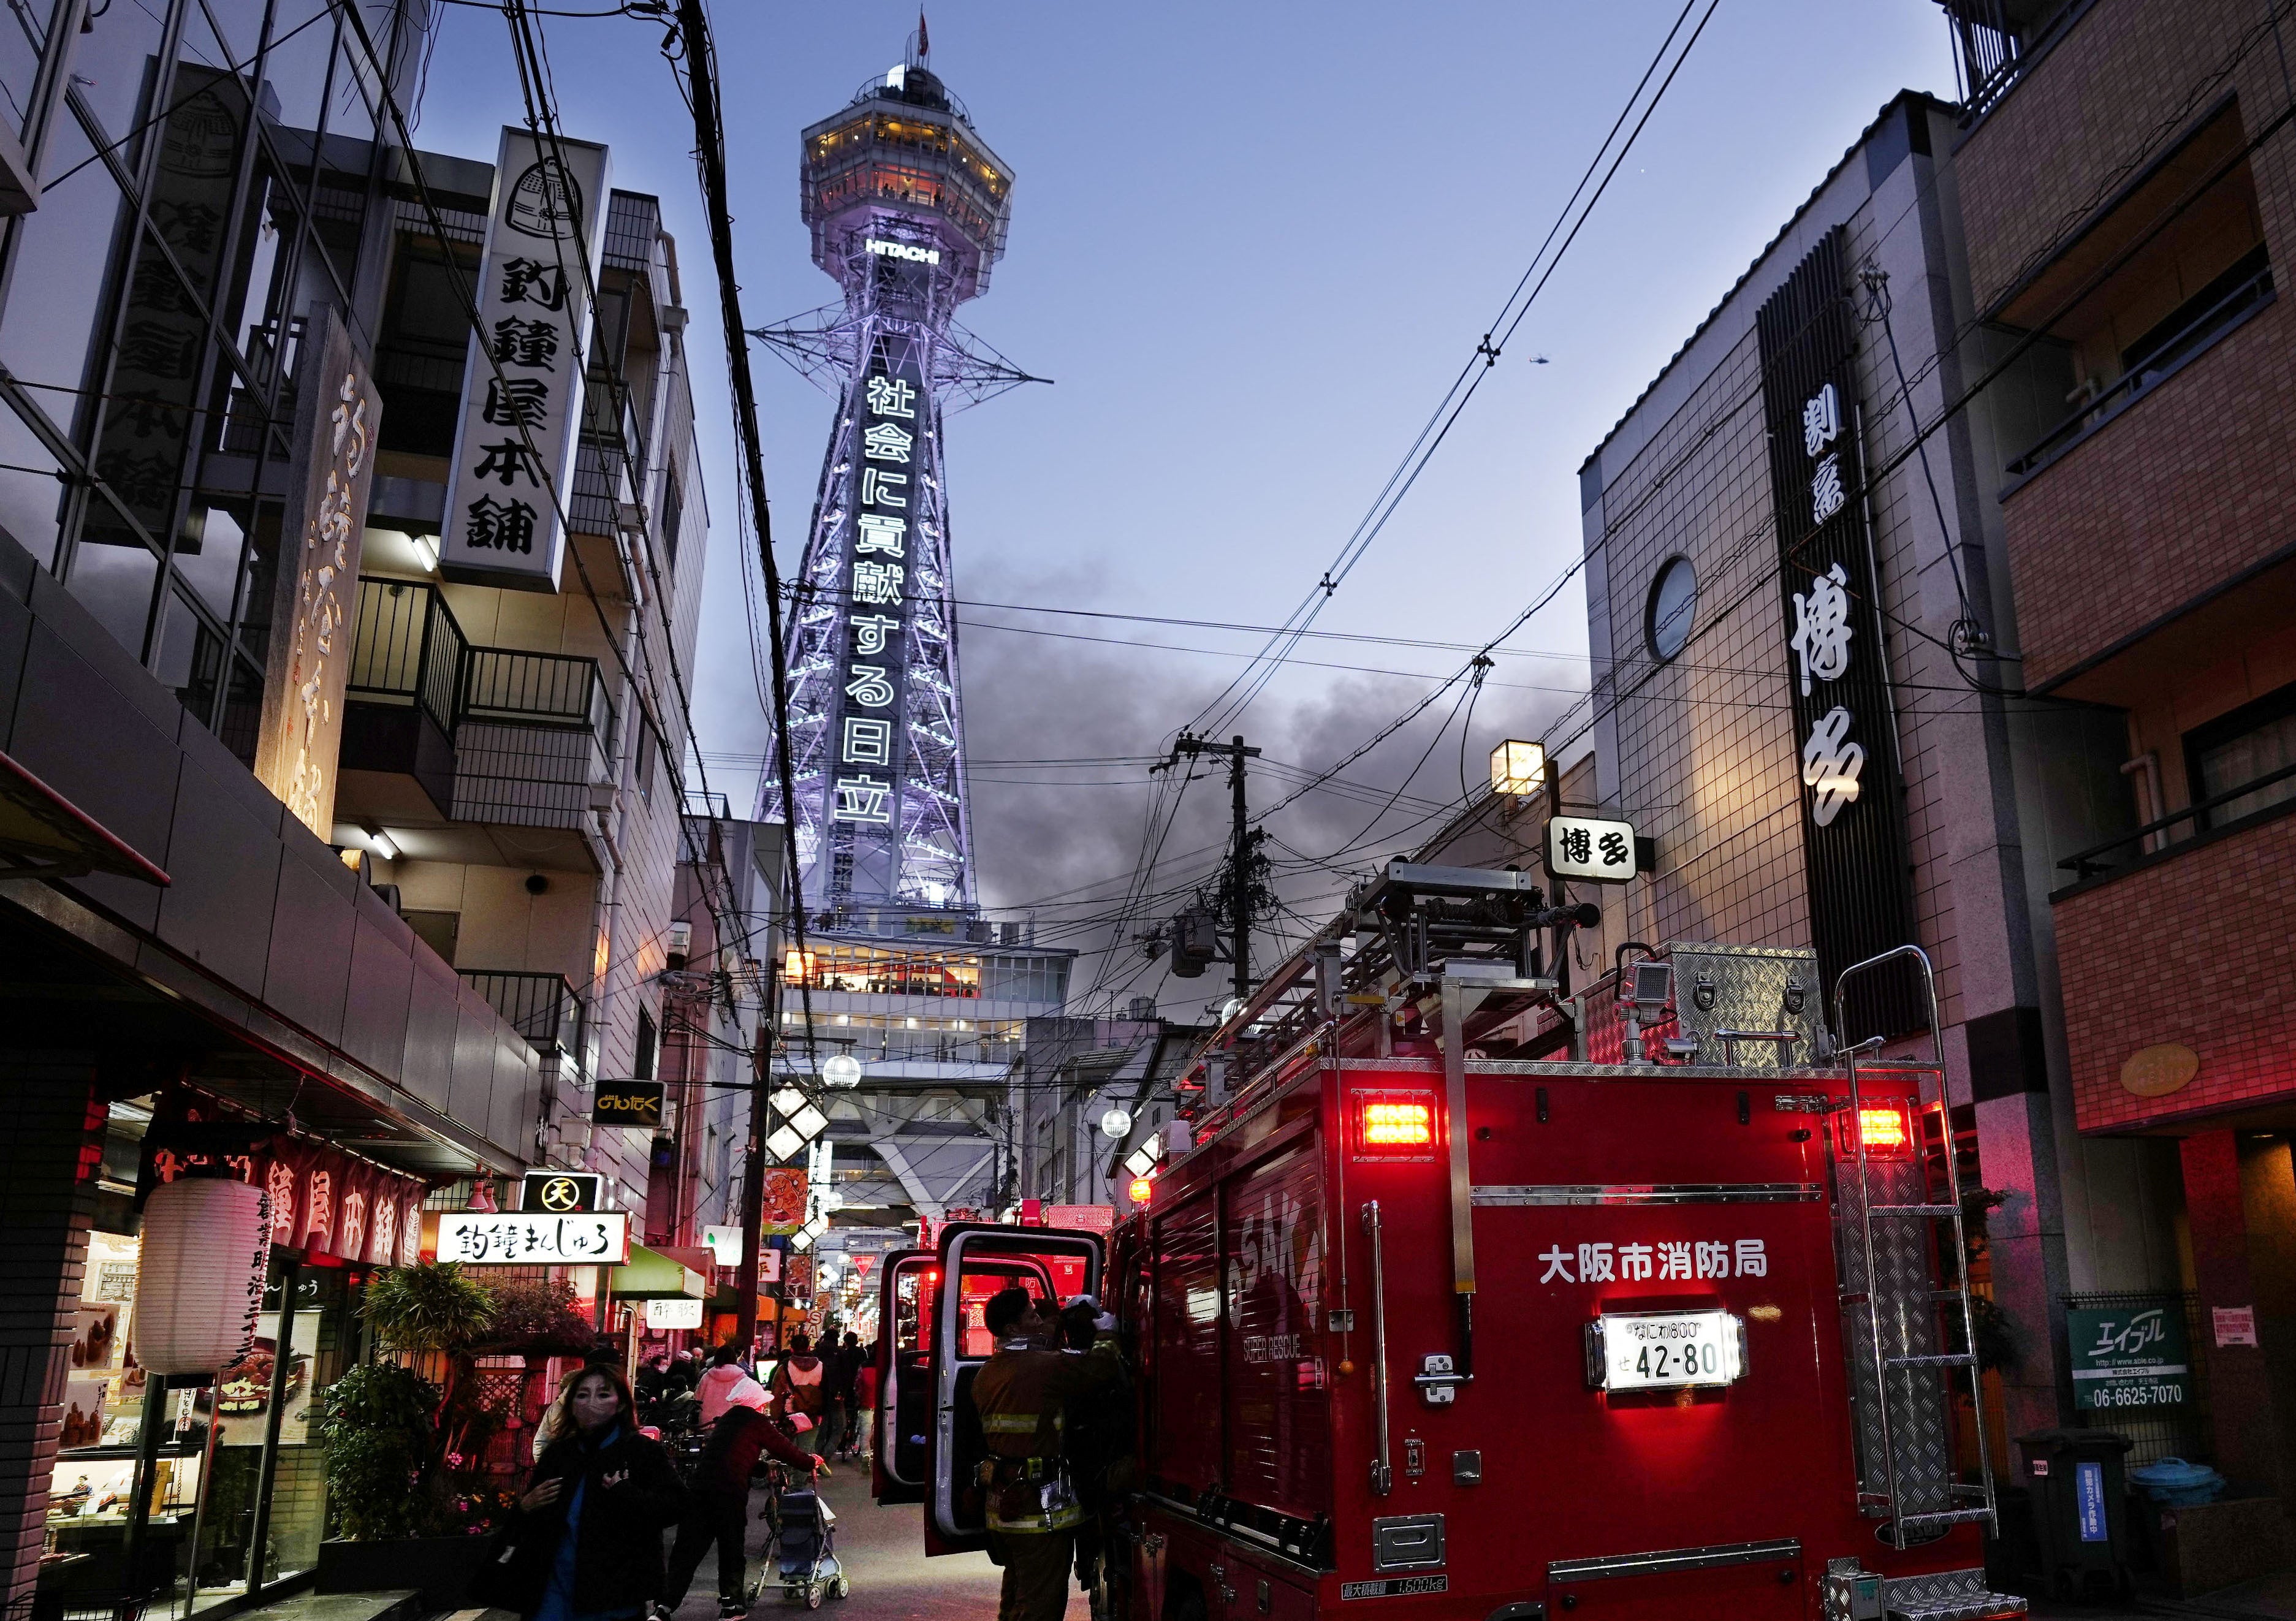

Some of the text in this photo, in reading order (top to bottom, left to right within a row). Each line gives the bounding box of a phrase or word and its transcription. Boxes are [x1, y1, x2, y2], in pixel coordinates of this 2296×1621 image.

[865, 238, 940, 266] HITACHI
[466, 257, 566, 554] 釣鐘屋本舗
[834, 376, 916, 824] 社会に貢献する日立
[1790, 562, 1865, 828] 博多
[1559, 827, 1629, 866] 博多
[455, 1218, 609, 1259] 釣鐘まんじゅう
[1228, 1191, 1319, 1334] OSAKA
[1538, 1239, 1768, 1285] 大阪市消防局
[1243, 1333, 1301, 1362] SUPER RESCUE
[2091, 1313, 2165, 1356] エイブル
[1636, 1342, 1717, 1378] 42-80
[2094, 1385, 2183, 1408] 06-6625-7070
[1343, 1582, 1387, 1598] 最大積載量
